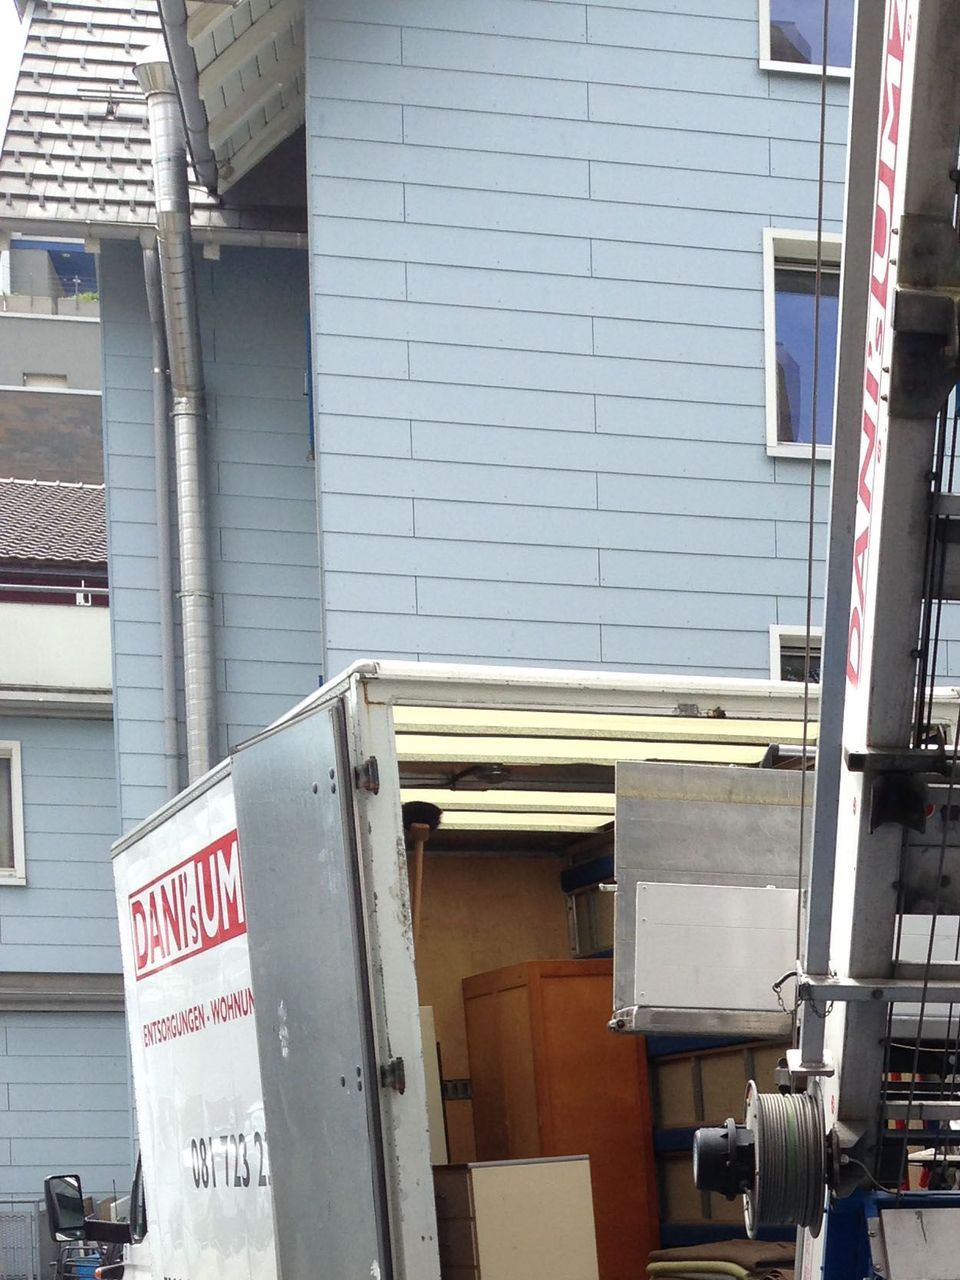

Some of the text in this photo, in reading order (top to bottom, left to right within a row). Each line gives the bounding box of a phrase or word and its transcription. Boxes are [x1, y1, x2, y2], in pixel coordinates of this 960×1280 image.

[143, 1003, 206, 1048] ENTSORGUNGEN
[191, 1131, 271, 1189] 081 723 2
